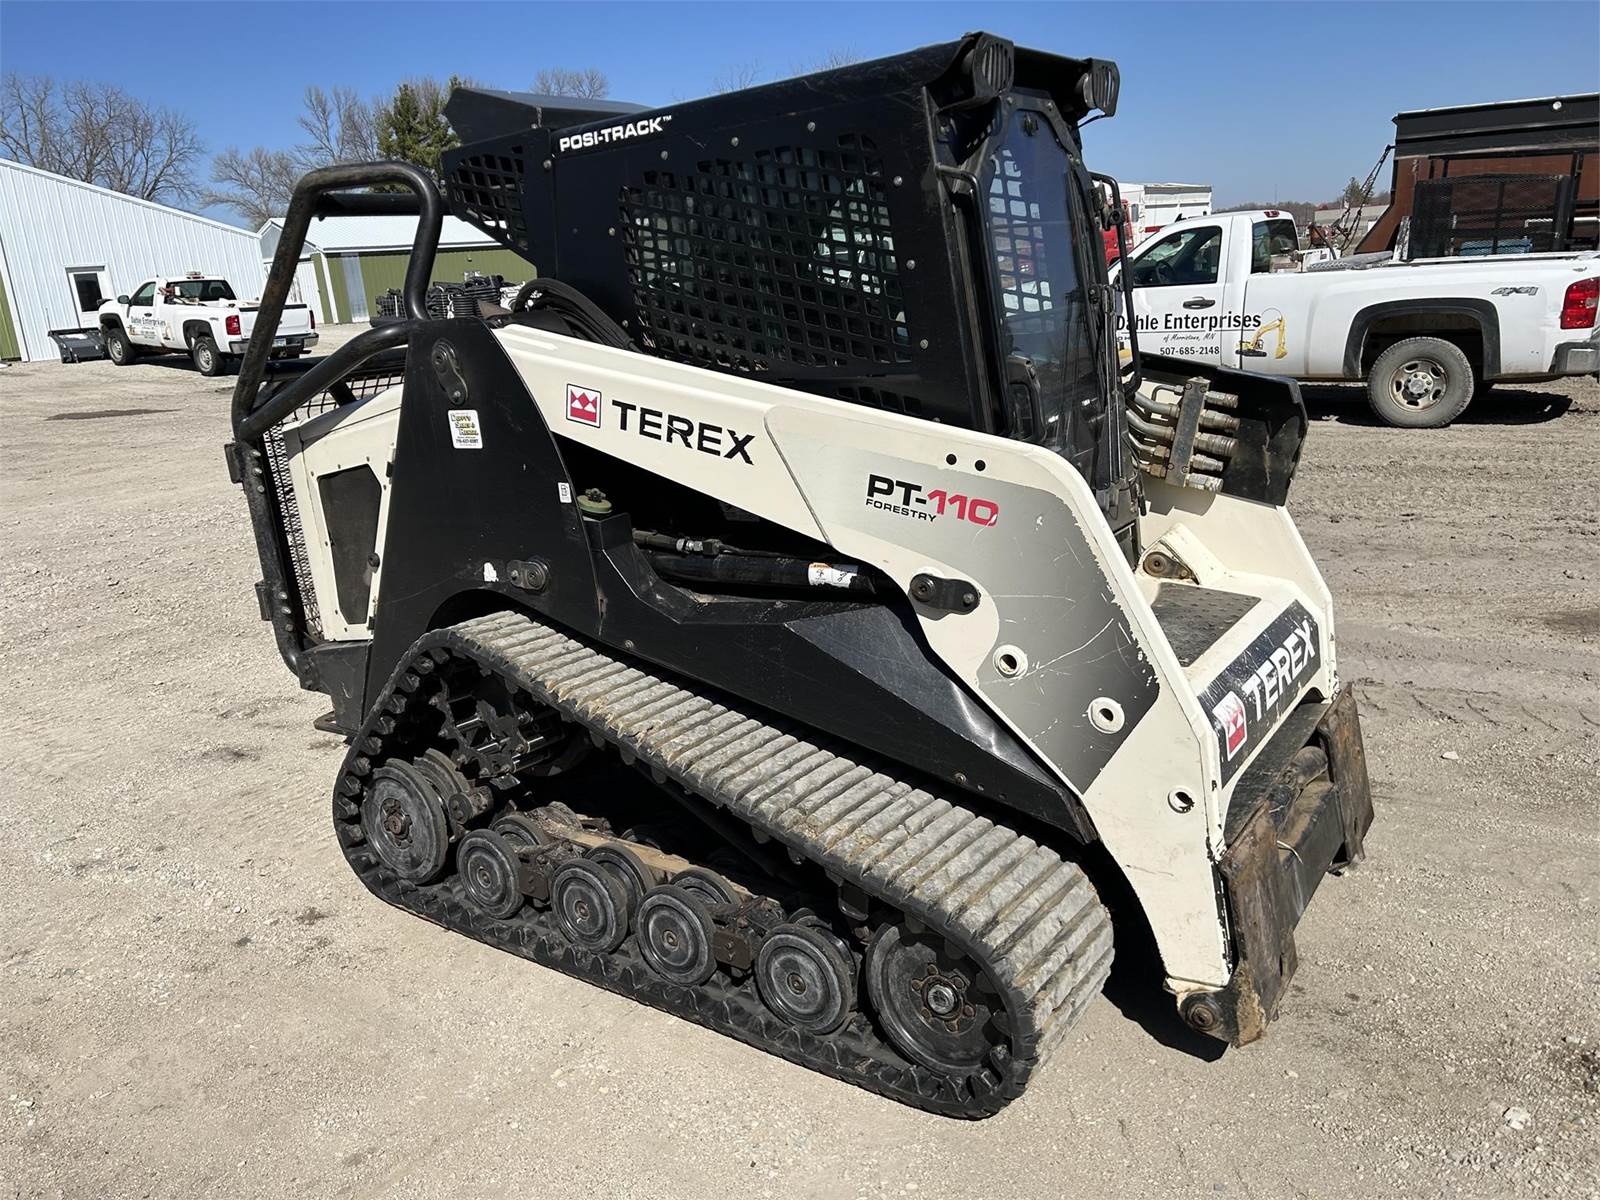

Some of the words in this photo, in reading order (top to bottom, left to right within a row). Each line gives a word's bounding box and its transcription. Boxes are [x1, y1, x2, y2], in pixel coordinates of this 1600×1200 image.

[1164, 310, 1262, 331] Enterprises
[1159, 345, 1220, 356] 507-685-2148
[611, 399, 756, 466] TEREX
[865, 498, 937, 523] FORESTRY
[867, 473, 999, 527] PT-110
[1240, 619, 1316, 723] TEREX
